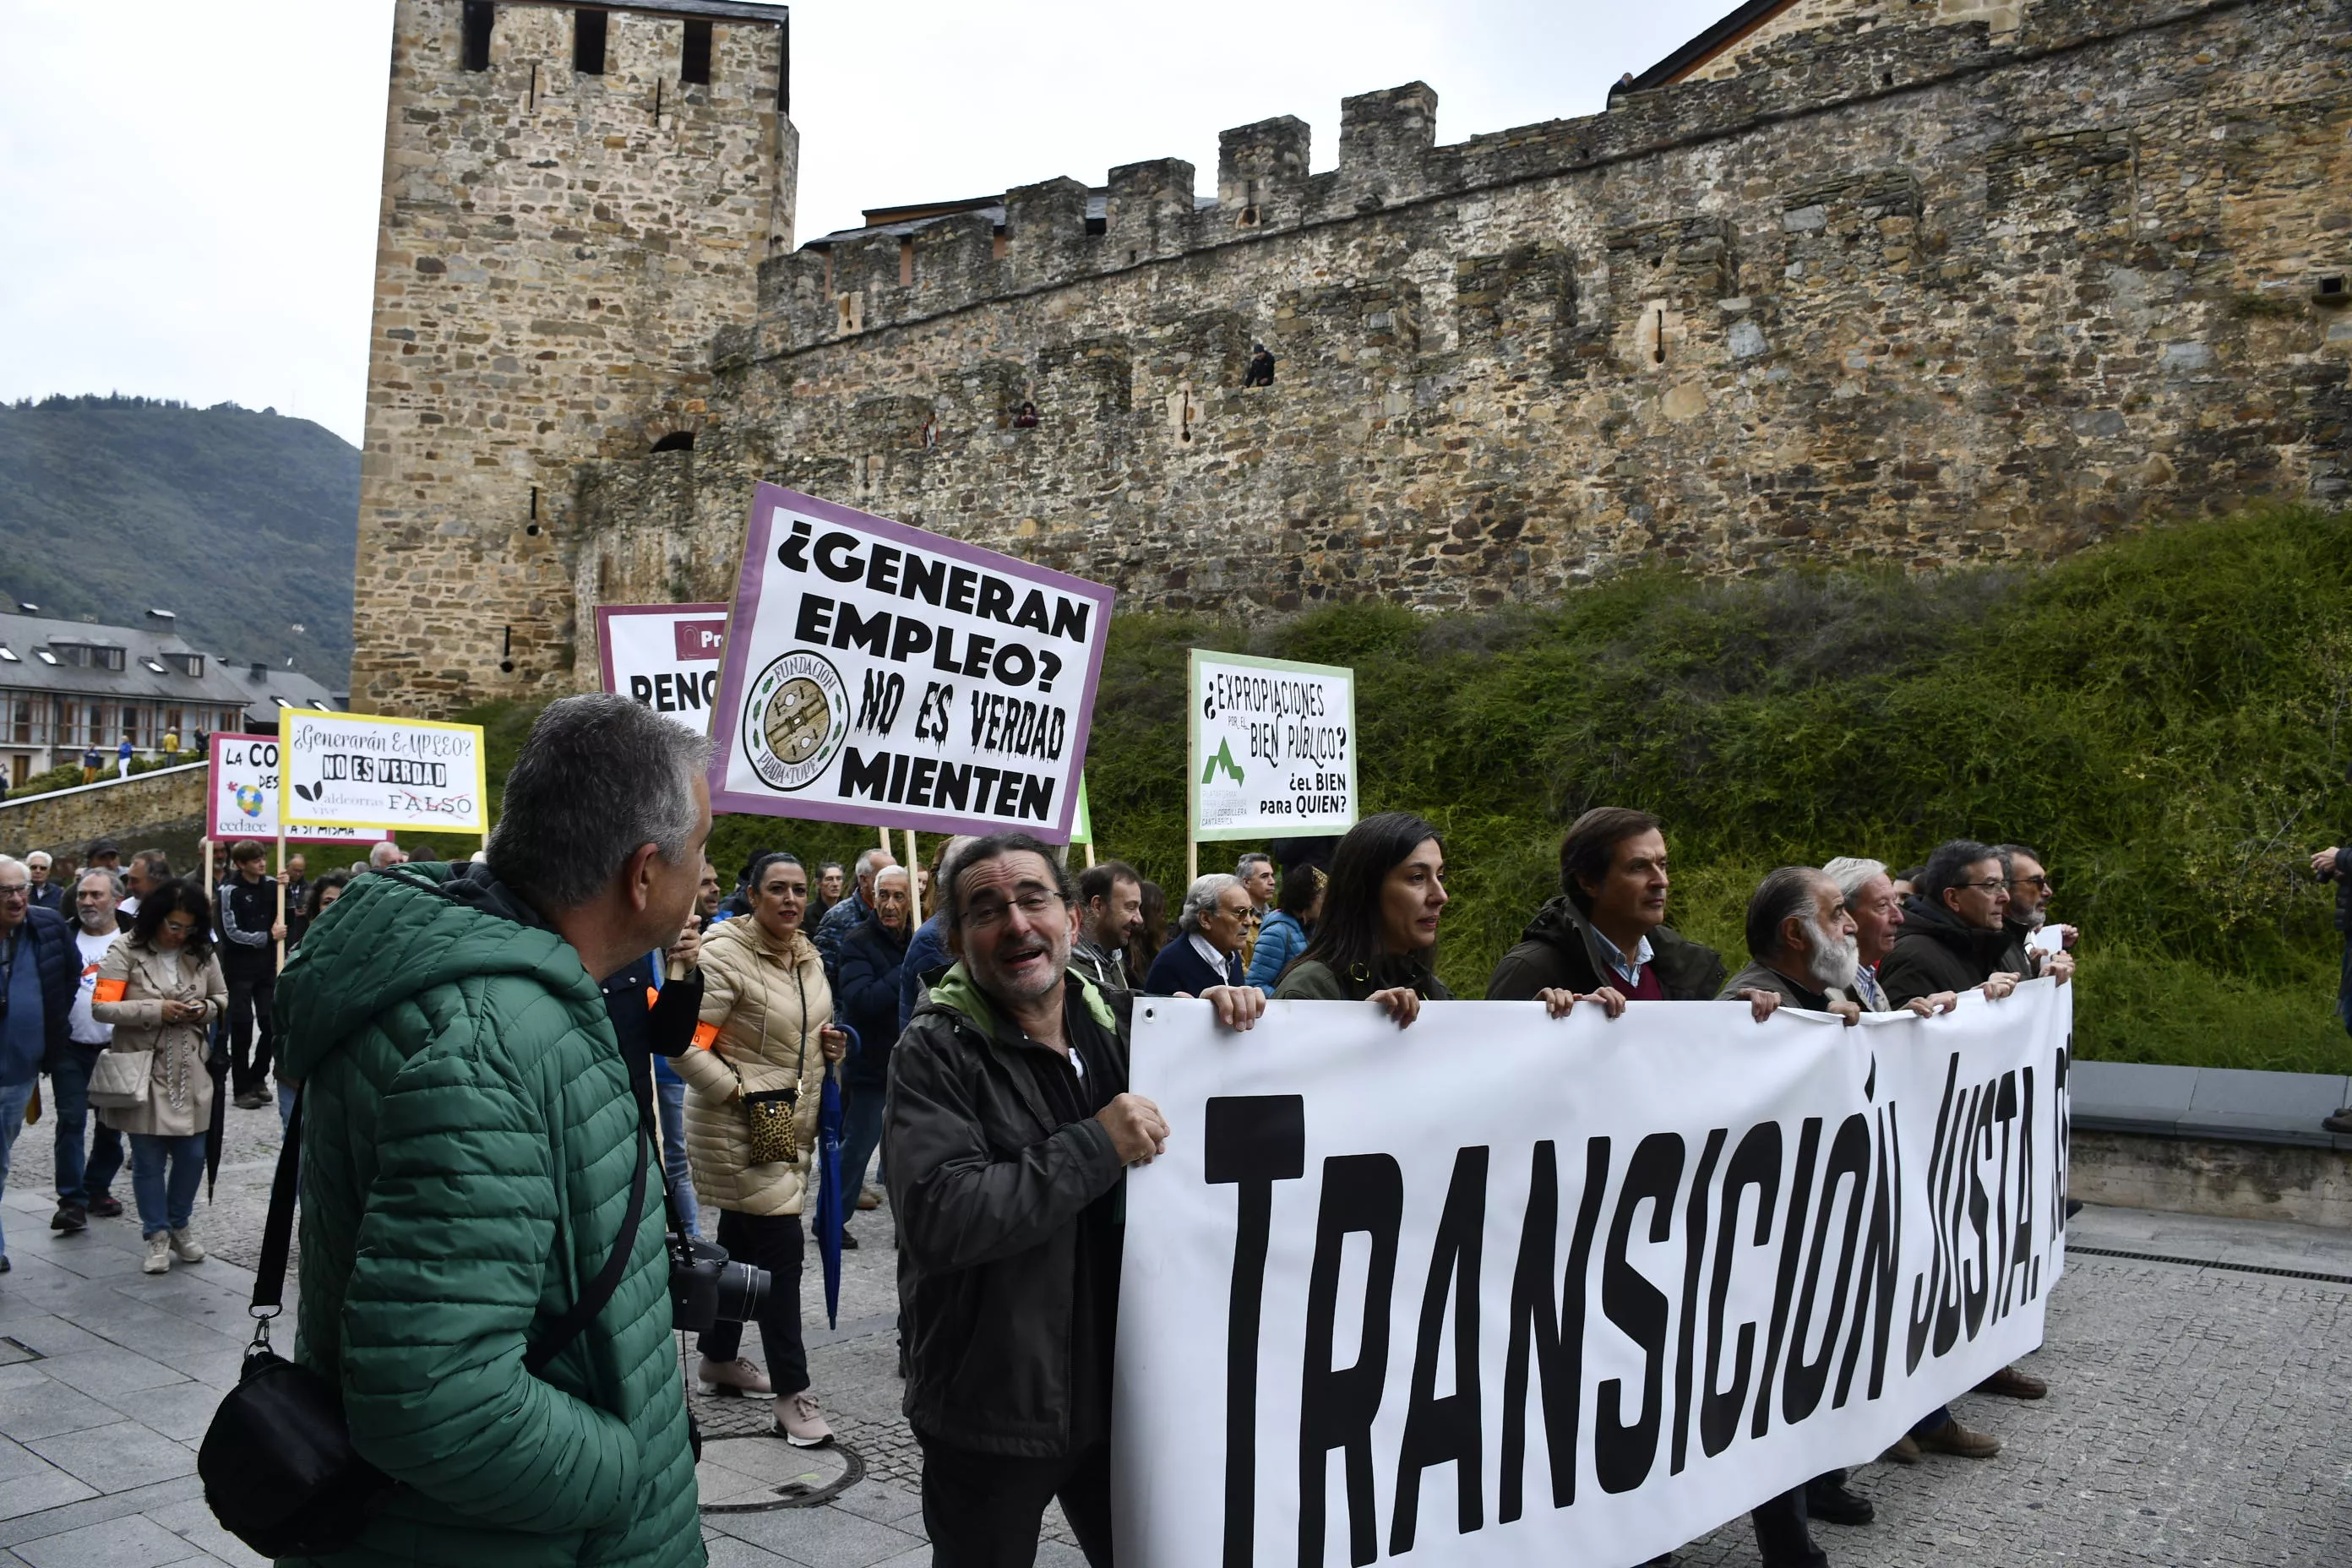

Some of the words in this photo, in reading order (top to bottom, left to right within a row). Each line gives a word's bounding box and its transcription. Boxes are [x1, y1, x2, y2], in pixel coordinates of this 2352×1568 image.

[777, 520, 1091, 644] ¿GENERAN
[700, 630, 724, 648] Pr
[794, 592, 1063, 694] EMPLEO?
[772, 656, 837, 691] FUNDACIÓN
[1204, 673, 1325, 720] ¿EXPROPIACIONES
[855, 667, 905, 738] NO
[915, 681, 954, 752] ES
[971, 689, 1066, 762] VERDAD
[1228, 716, 1241, 730] POR
[1240, 716, 1250, 731] EL
[294, 725, 386, 753] ¿Generarán
[1251, 720, 1280, 768] BIEN
[226, 749, 242, 765] LA
[323, 754, 346, 781] NO
[351, 755, 373, 782] ES
[378, 759, 446, 787] VERDAD
[756, 749, 787, 784] PRADA
[789, 758, 819, 784] TOPE
[838, 746, 1056, 821] MIENTEN
[1315, 772, 1346, 791] BIEN
[388, 794, 471, 814] FALSO
[1296, 795, 1347, 818] QUIEN?
[1205, 1053, 1902, 1568] TRANSICIÓN
